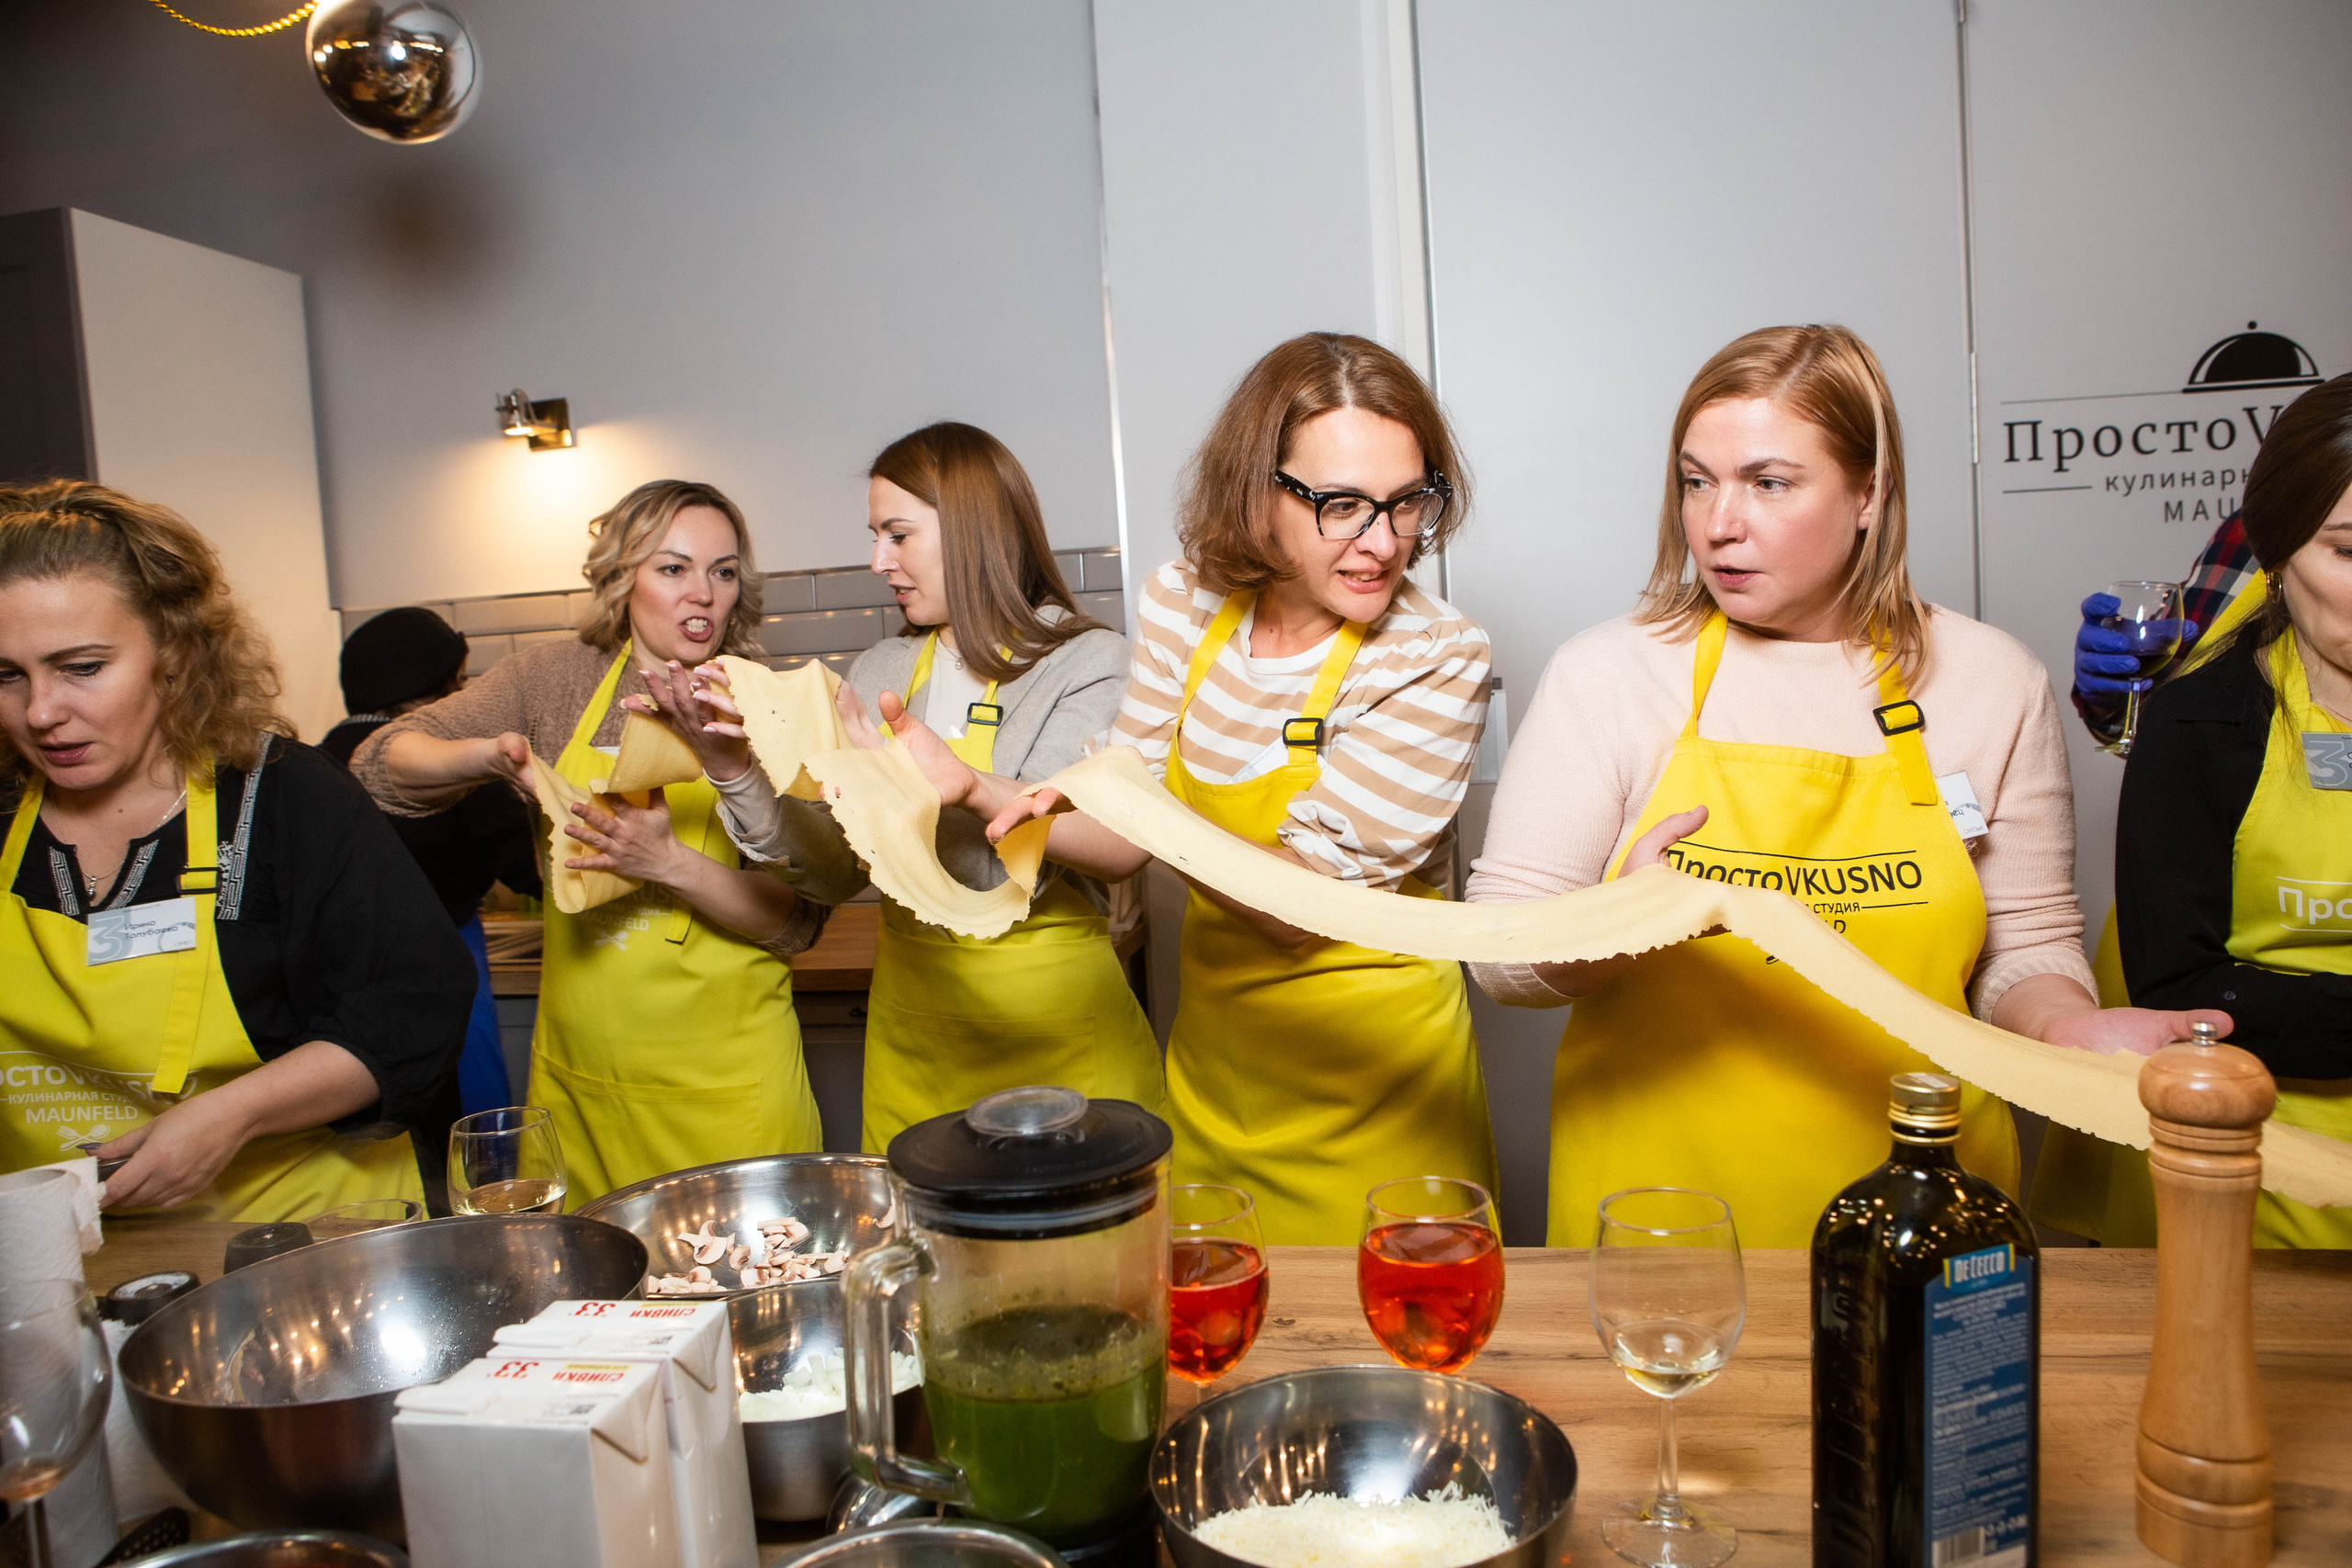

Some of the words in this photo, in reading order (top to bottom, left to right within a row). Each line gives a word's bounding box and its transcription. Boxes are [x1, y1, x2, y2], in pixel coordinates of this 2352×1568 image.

[1813, 902, 1860, 915] СТУДИЯ
[124, 919, 156, 931] Ирина
[8, 1090, 98, 1104] КУЛИНАРНАЯ
[25, 1105, 138, 1123] MAUNFELD
